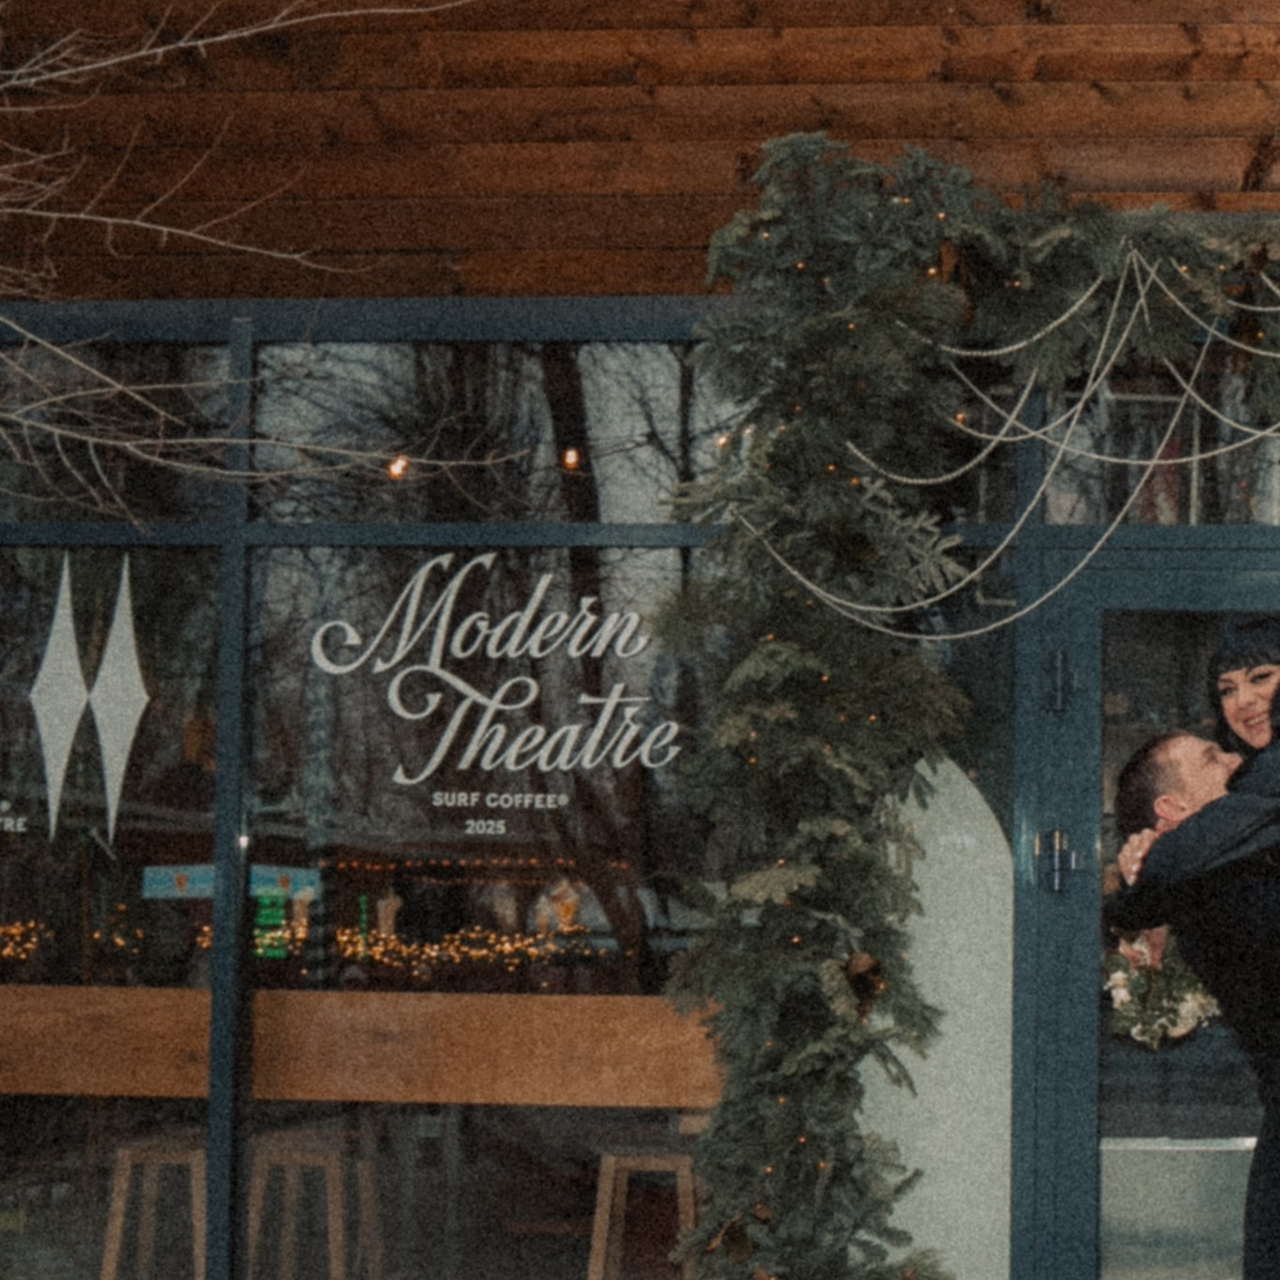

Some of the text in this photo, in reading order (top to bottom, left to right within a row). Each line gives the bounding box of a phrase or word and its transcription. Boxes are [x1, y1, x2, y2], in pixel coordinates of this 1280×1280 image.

[311, 553, 649, 674] Modern
[388, 665, 682, 785] Theatre
[432, 791, 481, 807] SURF
[465, 820, 507, 835] 2025
